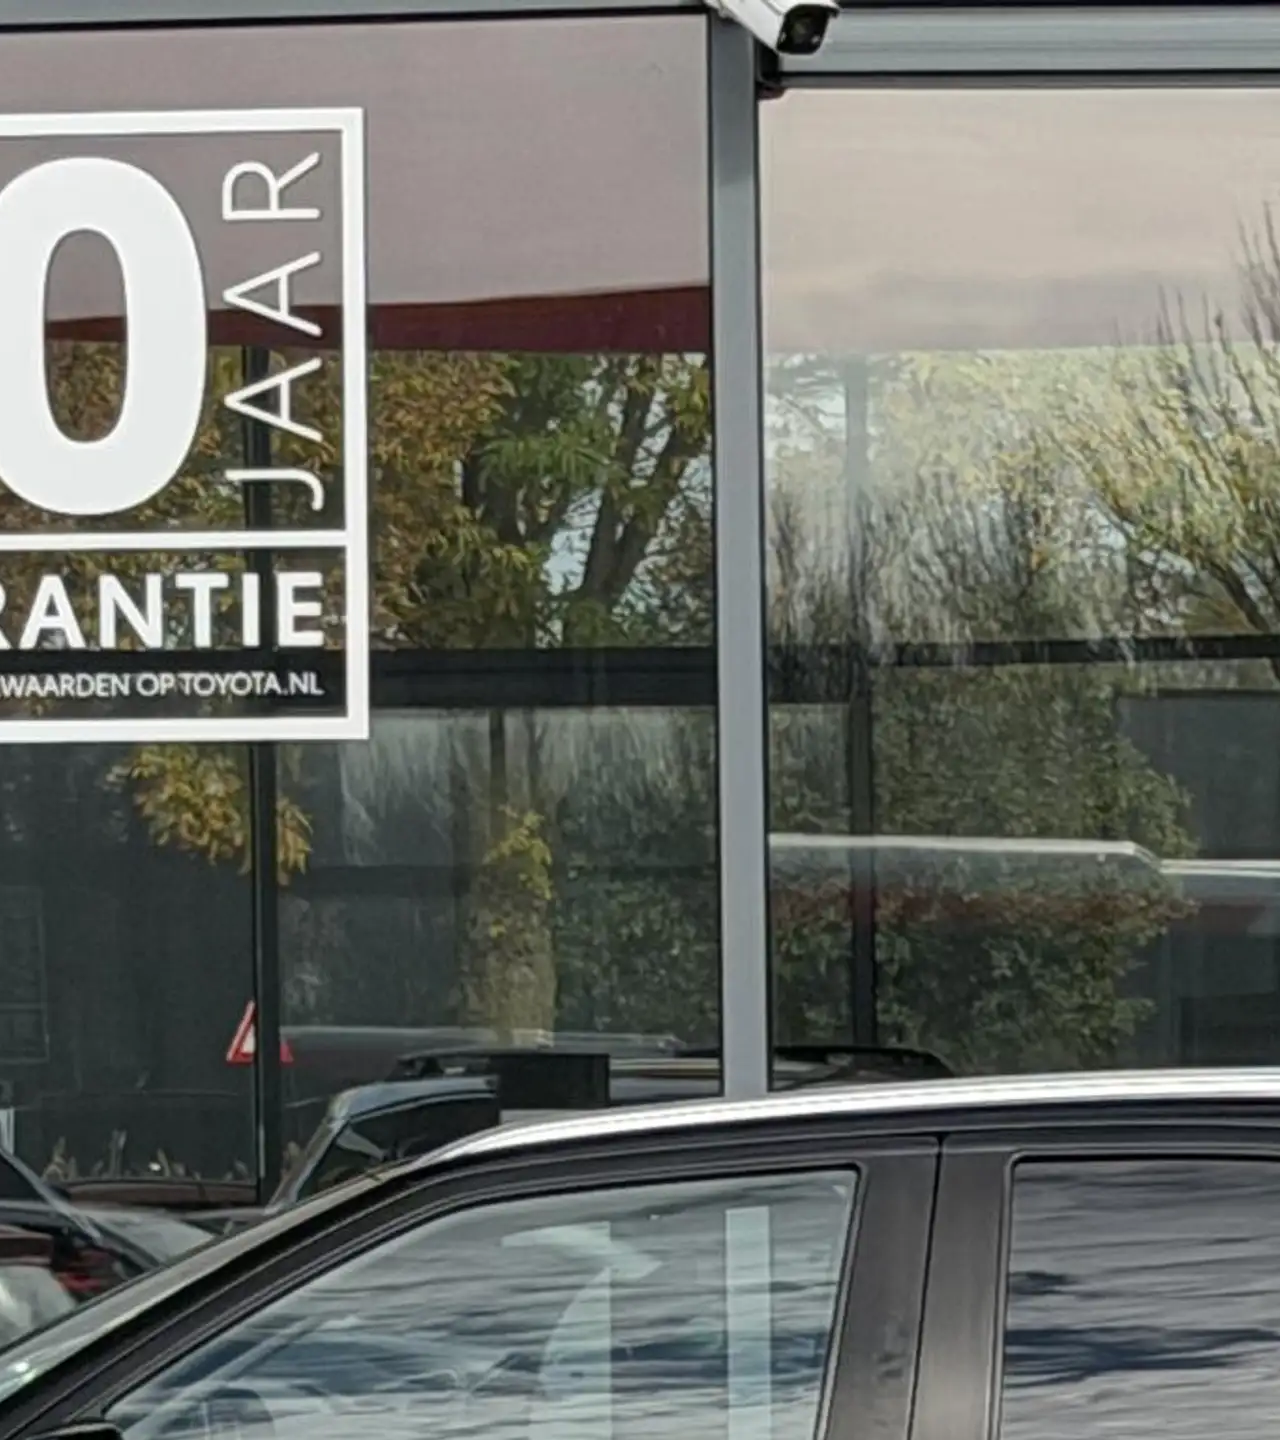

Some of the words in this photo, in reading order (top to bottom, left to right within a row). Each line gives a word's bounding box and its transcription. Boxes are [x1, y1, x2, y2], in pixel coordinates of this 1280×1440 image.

[223, 151, 323, 511] JAAR
[136, 671, 175, 696] OP
[178, 669, 324, 696] TOYOTA.NL
